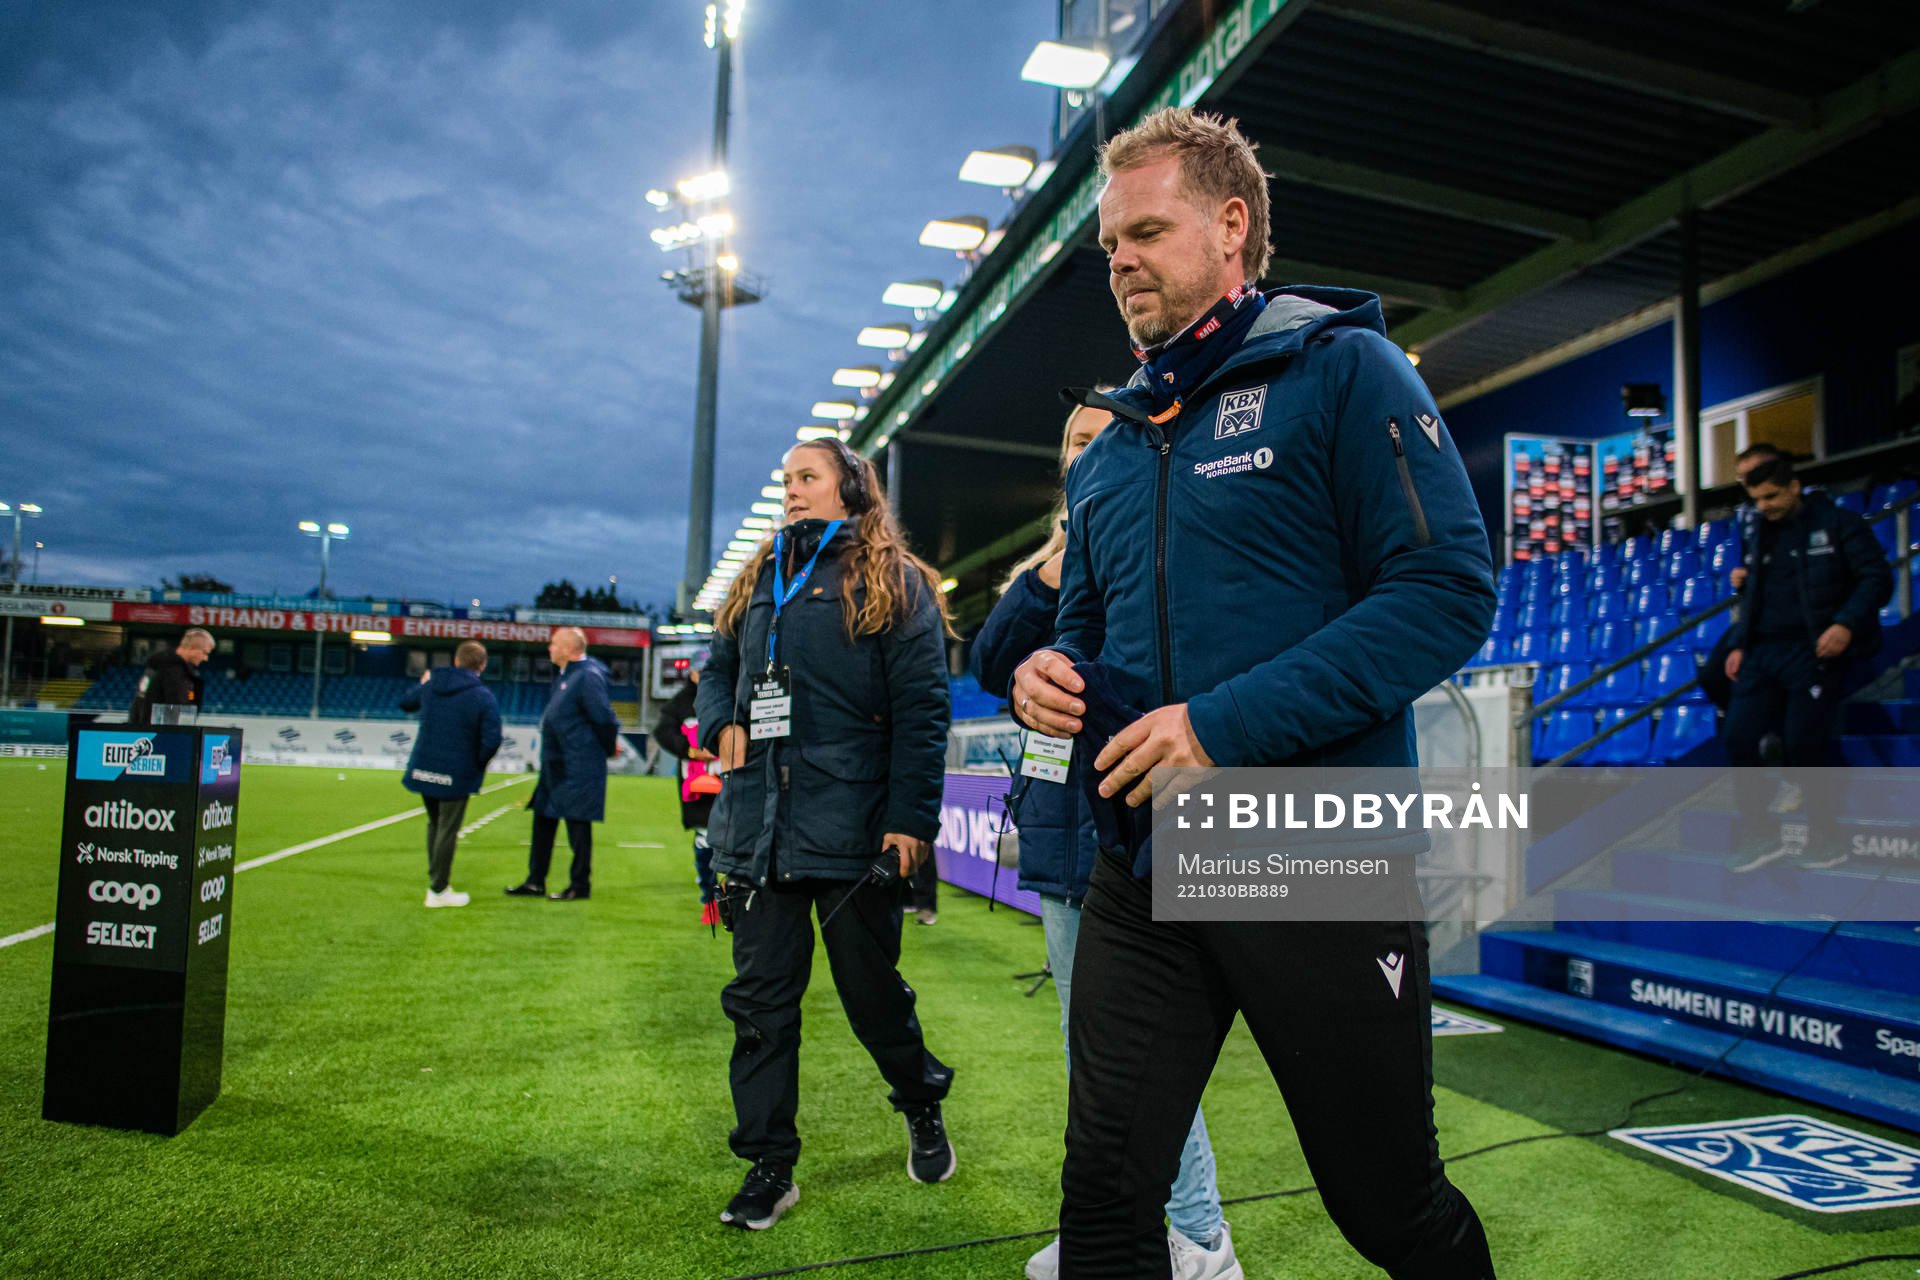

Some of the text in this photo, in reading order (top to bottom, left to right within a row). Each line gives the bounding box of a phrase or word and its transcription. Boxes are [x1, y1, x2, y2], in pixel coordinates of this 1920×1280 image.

[1224, 390, 1262, 412] KBK
[1193, 451, 1253, 475] SpareBank
[1206, 463, 1254, 480] NORDMØRE
[189, 606, 286, 630] STRAND
[290, 614, 307, 631] &
[105, 743, 134, 764] ELITE
[130, 757, 164, 773] SERIEN
[84, 799, 176, 832] altibox
[202, 799, 233, 832] altibox
[96, 846, 179, 870] Norsk Tipping
[88, 880, 162, 911] coop
[200, 875, 226, 904] coop
[86, 921, 157, 949] SELECT
[198, 913, 223, 946] SELECT
[1630, 978, 1844, 1051] SAMMEN ER VI KBK
